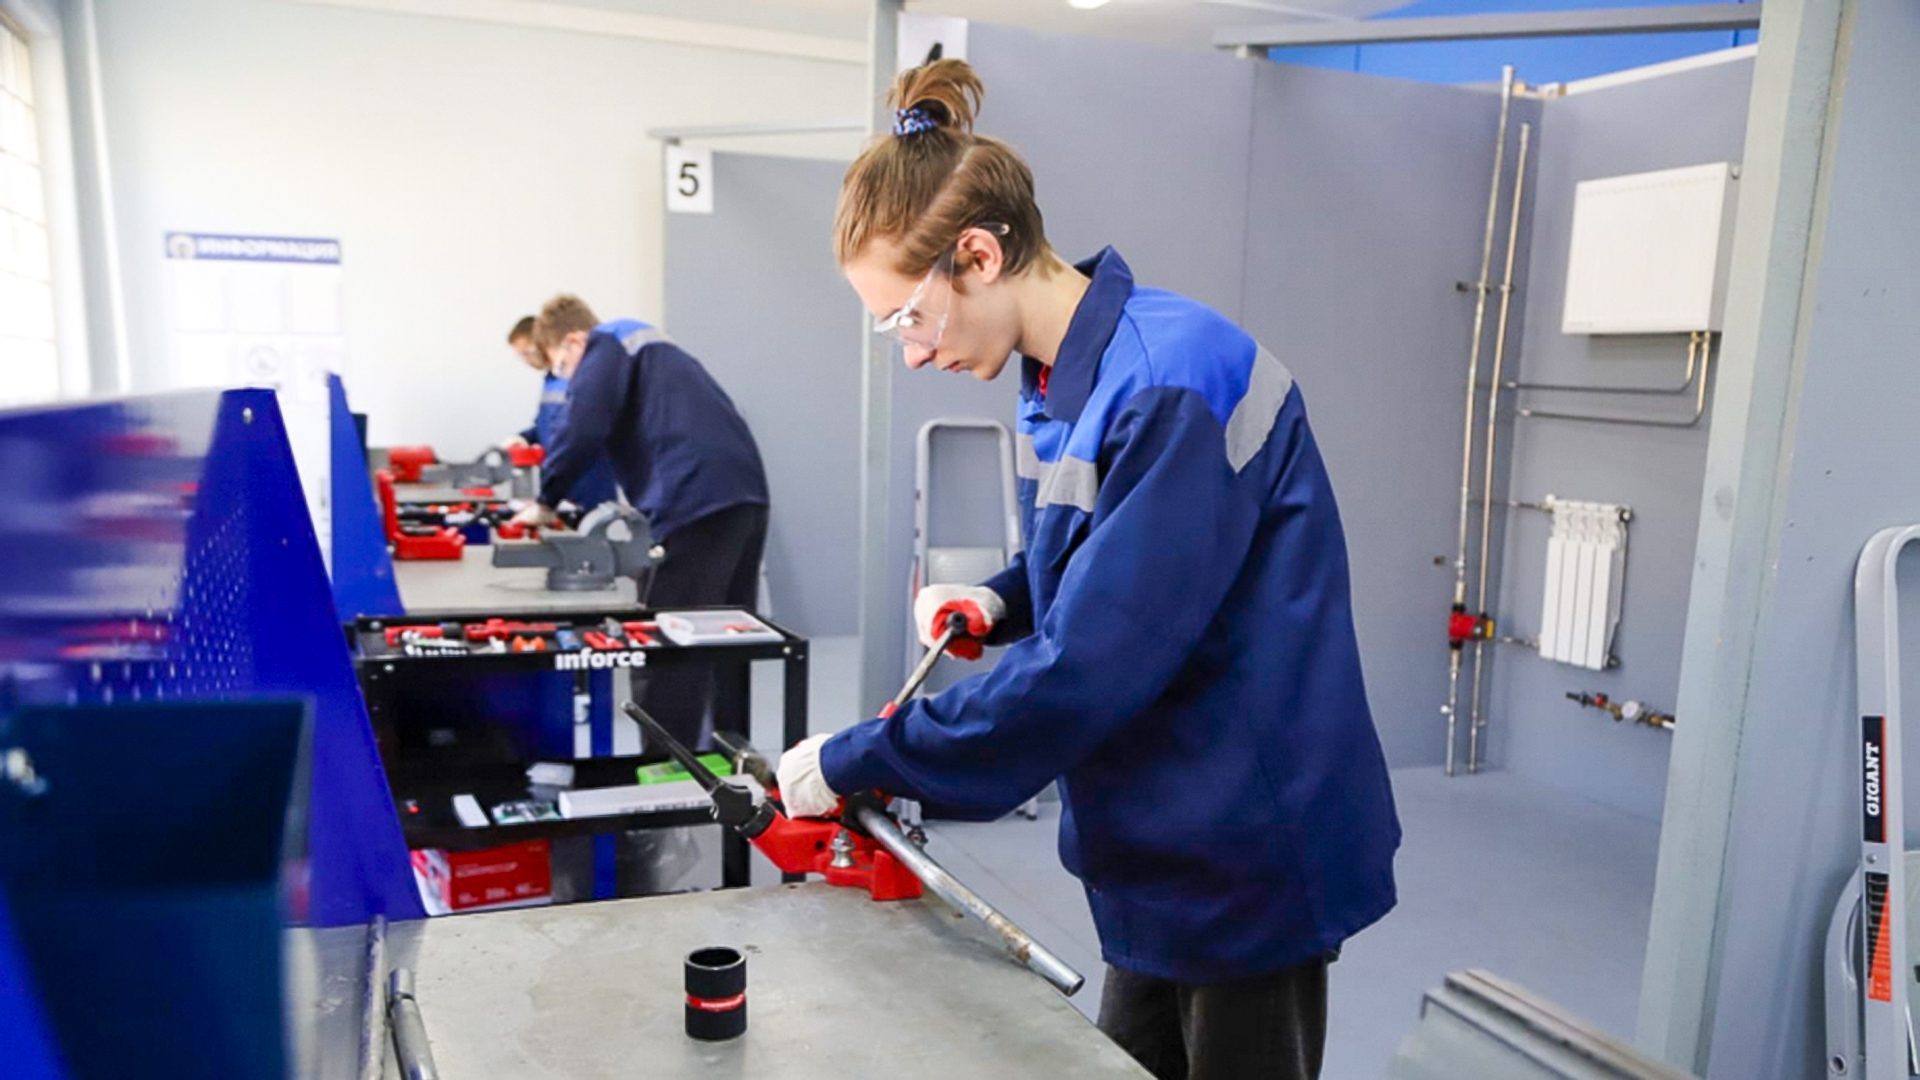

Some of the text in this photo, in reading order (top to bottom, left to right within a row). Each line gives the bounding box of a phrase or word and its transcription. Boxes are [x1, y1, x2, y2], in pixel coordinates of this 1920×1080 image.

[679, 162, 699, 198] 5
[555, 647, 646, 670] inforce
[1865, 741, 1880, 817] GIGANT
